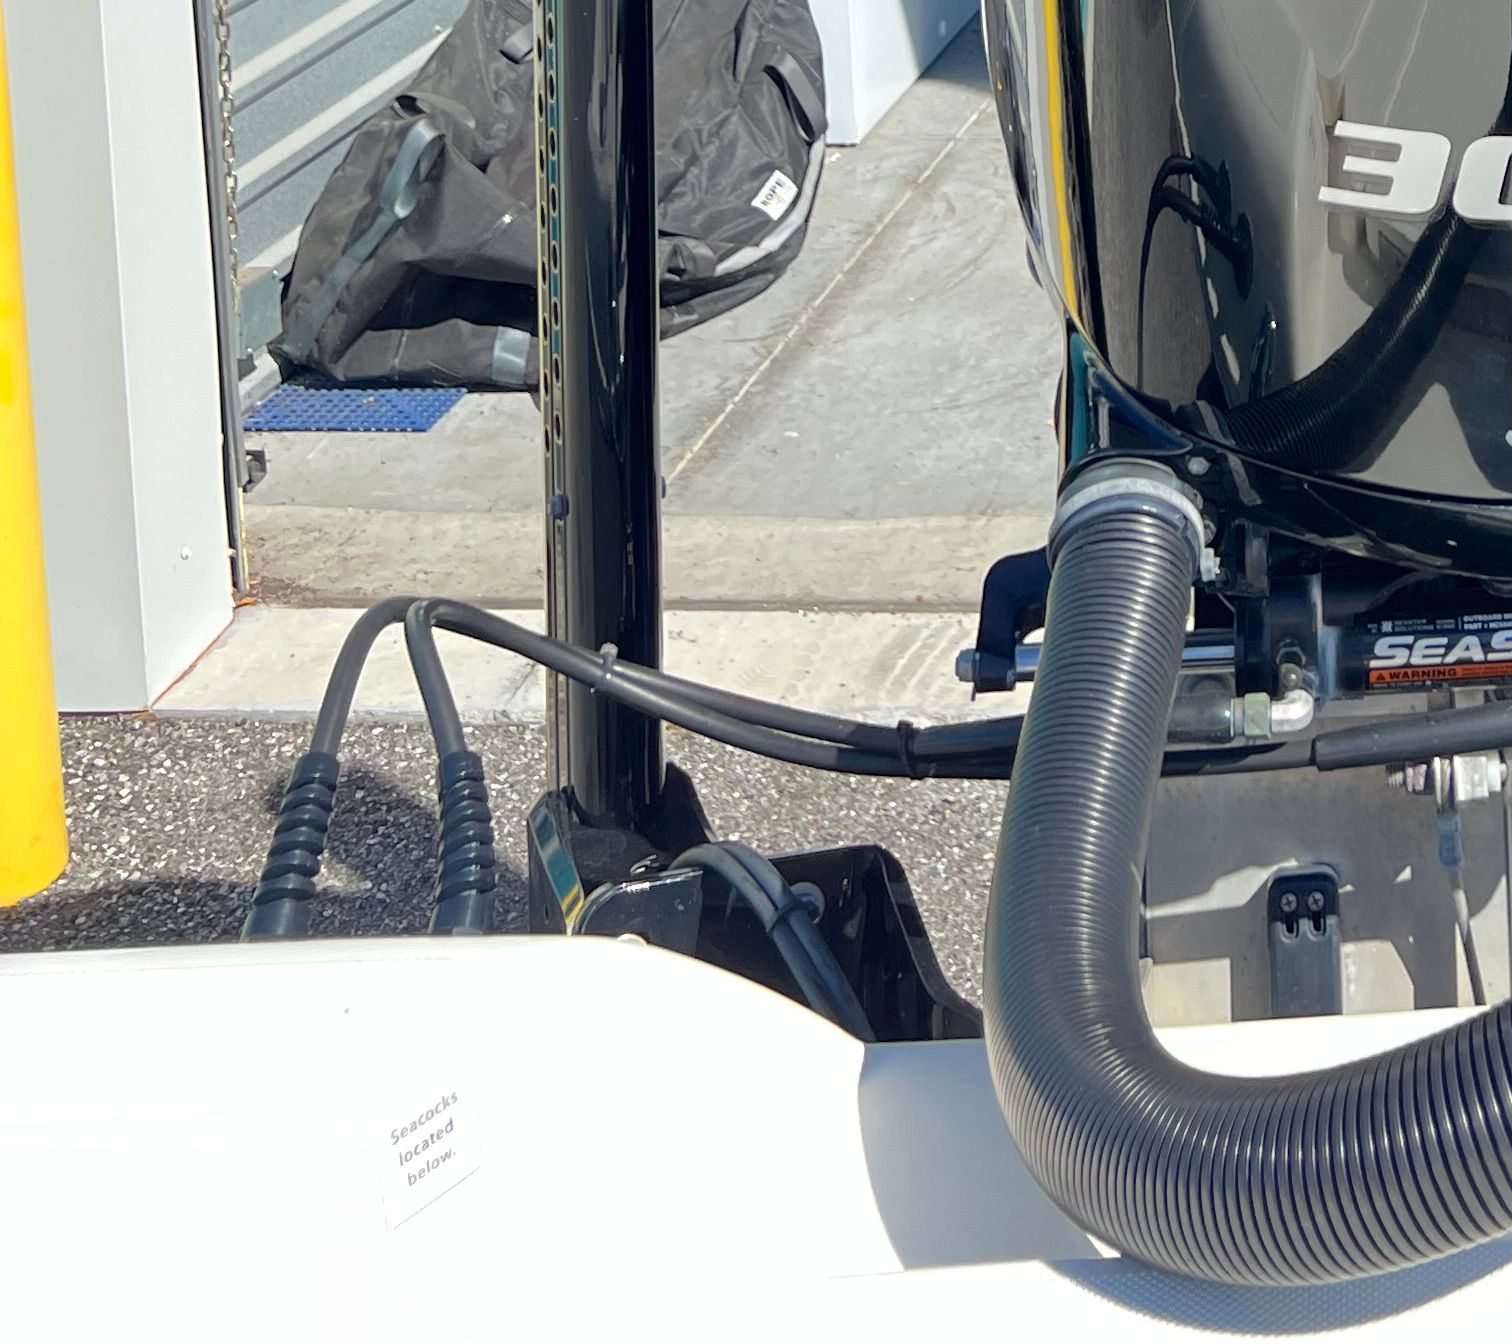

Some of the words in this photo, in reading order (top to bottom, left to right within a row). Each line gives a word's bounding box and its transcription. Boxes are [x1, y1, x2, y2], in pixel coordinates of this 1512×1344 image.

[1388, 667, 1458, 681] WARNING
[390, 1091, 458, 1145] Seacocks
[398, 1117, 454, 1167] located
[407, 1147, 456, 1187] below.
